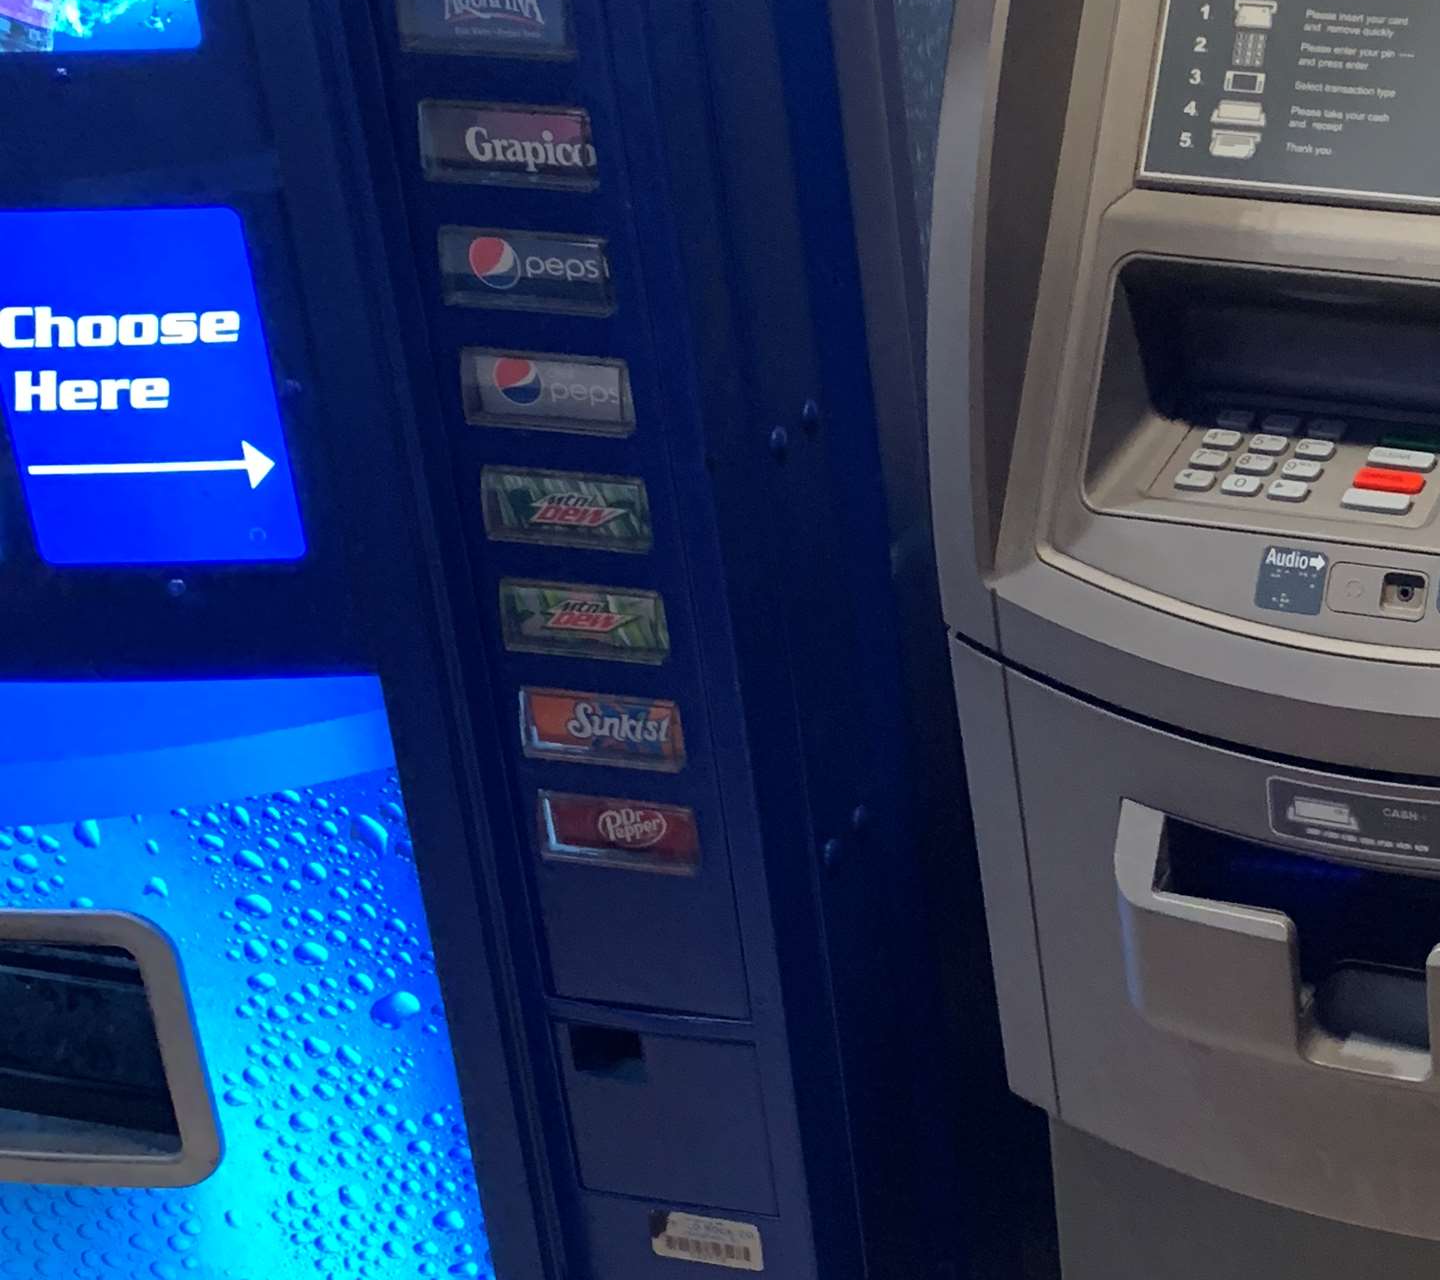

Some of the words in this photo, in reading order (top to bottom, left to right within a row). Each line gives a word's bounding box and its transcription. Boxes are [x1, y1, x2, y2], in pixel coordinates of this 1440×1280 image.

[1305, 8, 1337, 22] Please
[1303, 23, 1322, 33] and
[1326, 25, 1361, 36] remove
[1362, 28, 1395, 40] quickly
[1300, 42, 1332, 55] Please
[1333, 46, 1357, 57] enter
[1359, 48, 1380, 59] your
[1380, 49, 1396, 60] pin
[1298, 57, 1316, 67] and
[1318, 60, 1344, 71] press
[1345, 61, 1370, 71] enter
[1294, 80, 1323, 93] Select
[1324, 84, 1375, 96] transaction
[1376, 87, 1397, 99] type
[1290, 105, 1322, 118] Please
[1345, 112, 1366, 123] your
[1367, 112, 1390, 123] cash
[1288, 118, 1307, 129] and
[465, 126, 598, 173] Grapico
[1285, 141, 1313, 154] Thank
[1314, 146, 1333, 158] you
[525, 255, 611, 282] pepsi
[0, 306, 241, 349] Choose
[14, 370, 170, 412] Here
[551, 382, 619, 406] peps
[1265, 547, 1309, 570] Audio
[567, 702, 670, 743] Sunkist
[621, 808, 641, 824] Dr
[1382, 807, 1419, 821] CASH
[604, 810, 661, 842] Pepper
